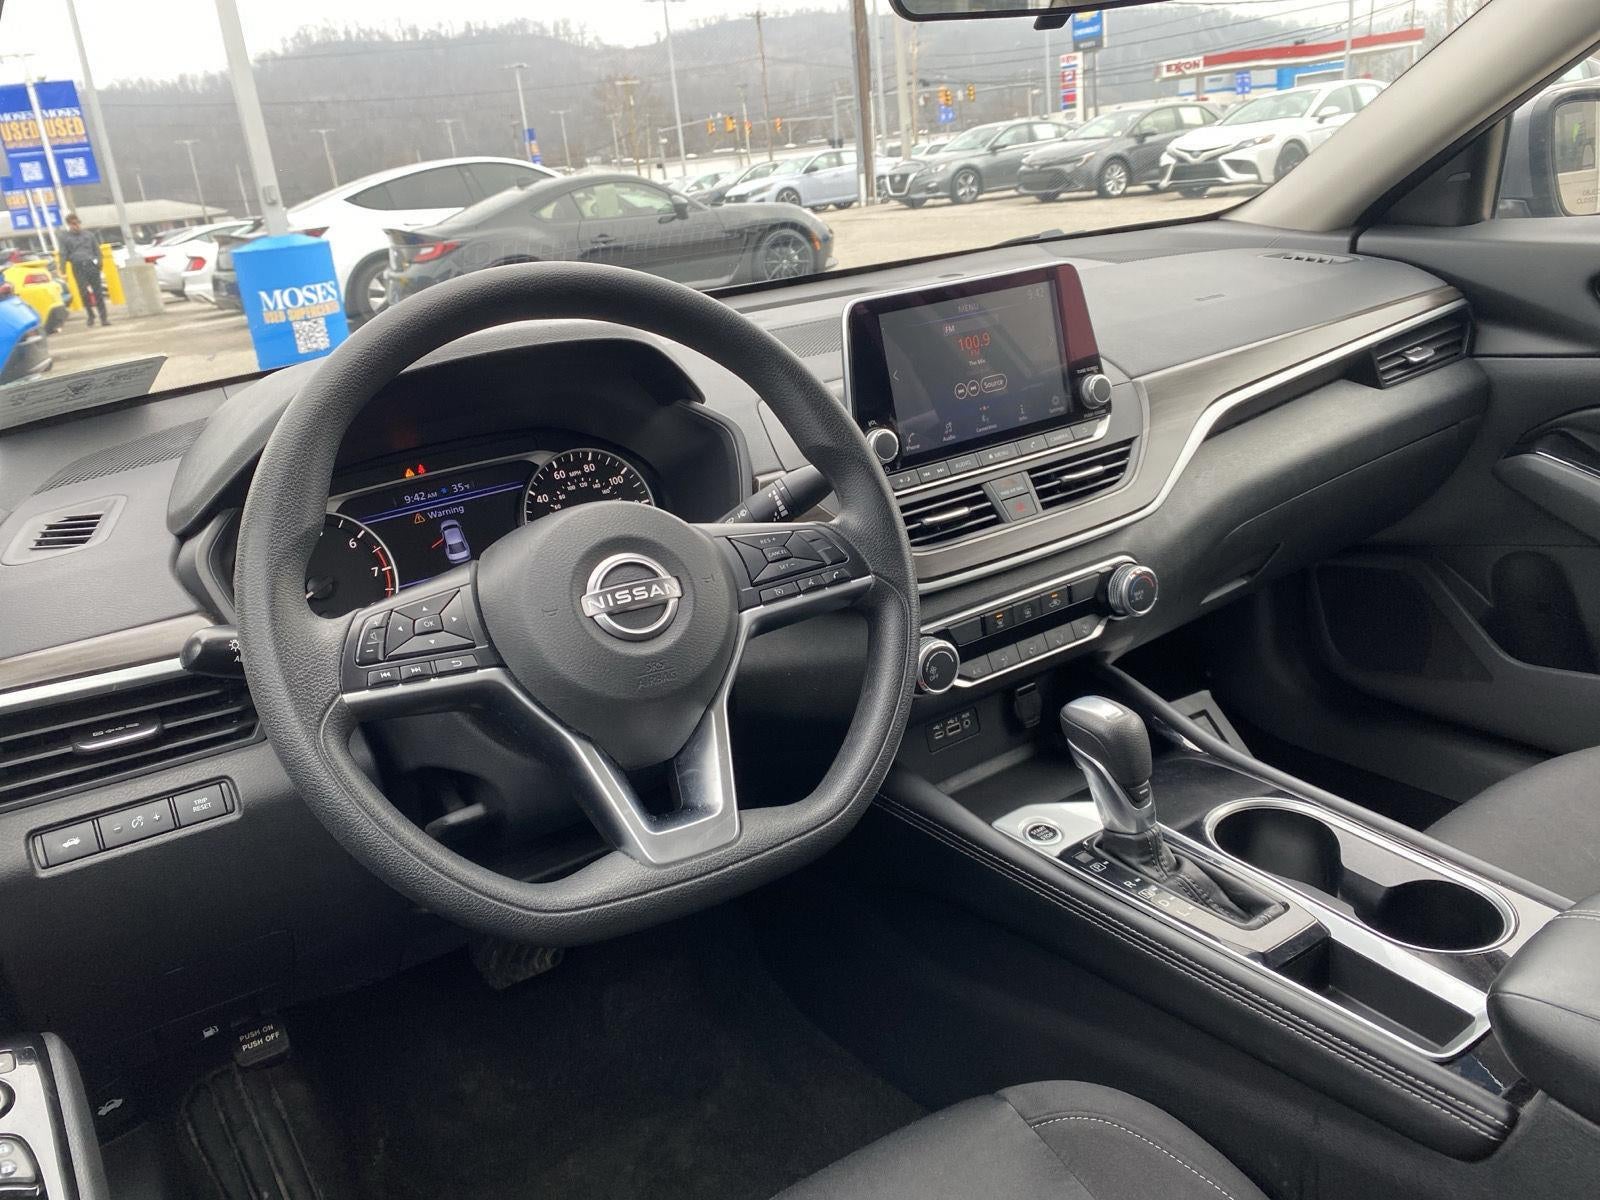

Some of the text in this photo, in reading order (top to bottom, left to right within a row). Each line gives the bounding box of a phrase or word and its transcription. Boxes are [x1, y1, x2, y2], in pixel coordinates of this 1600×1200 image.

[1166, 60, 1200, 74] EXXON
[0, 120, 40, 142] USED
[44, 116, 86, 138] USED
[258, 281, 337, 311] MOSES
[958, 332, 991, 352] 100.9
[984, 378, 1004, 390] Source
[553, 470, 566, 480] 60
[583, 463, 596, 473] 80
[608, 475, 624, 486] 100
[404, 491, 427, 504] 9:42
[427, 491, 438, 499] AM
[536, 494, 549, 504] 40
[427, 505, 465, 519] Warning
[348, 538, 357, 549] 6
[370, 567, 379, 577] 7
[586, 581, 679, 613] NISSAN
[423, 620, 435, 628] OK
[192, 802, 212, 812] RESET
[193, 797, 208, 805] TRIP
[1123, 880, 1137, 888] R
[1176, 909, 1191, 917] L
[239, 1023, 274, 1042] PUSH ON
[242, 1031, 280, 1052] PUSH OFF
